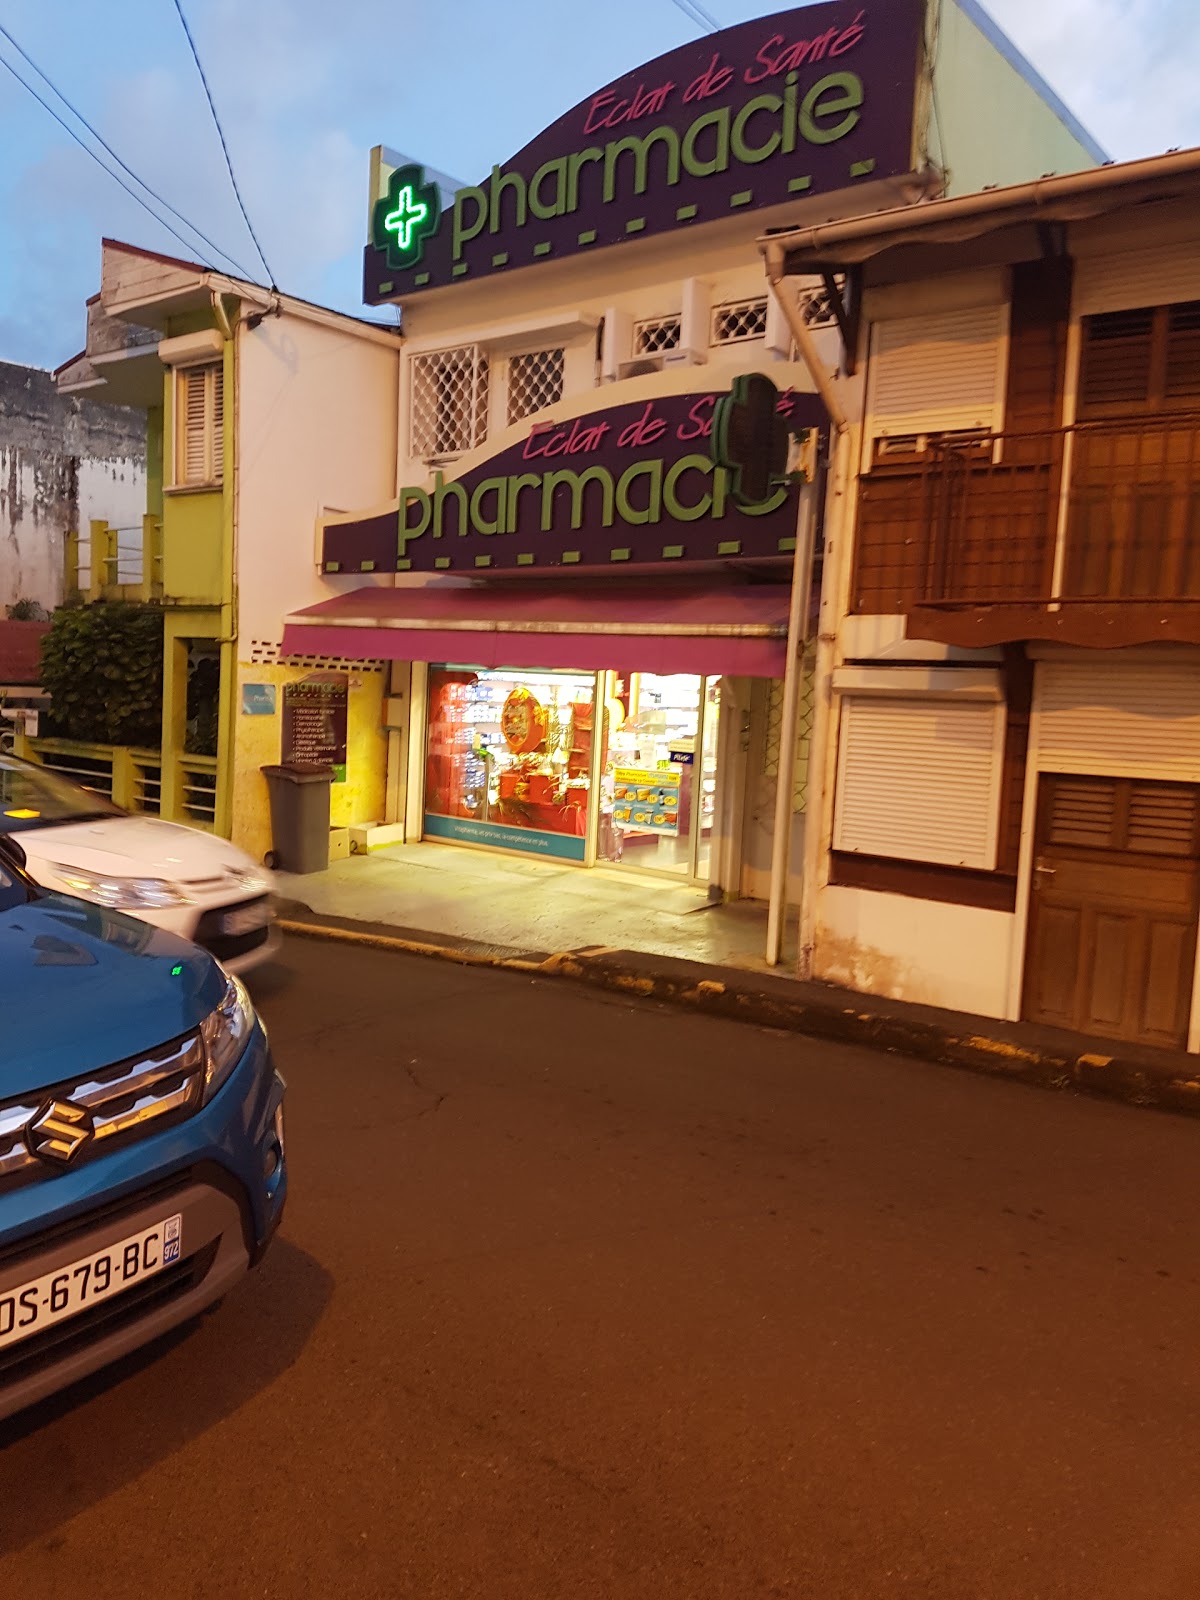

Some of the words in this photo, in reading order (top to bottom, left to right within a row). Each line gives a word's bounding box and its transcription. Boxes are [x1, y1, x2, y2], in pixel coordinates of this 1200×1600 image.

[584, 82, 676, 134] Eclat
[682, 53, 734, 104] de
[744, 9, 866, 84] Santé
[452, 70, 865, 261] pharmacie
[522, 419, 613, 460] Eclat
[617, 402, 668, 448] de
[676, 385, 796, 440] Saé
[164, 1241, 179, 1261] 972
